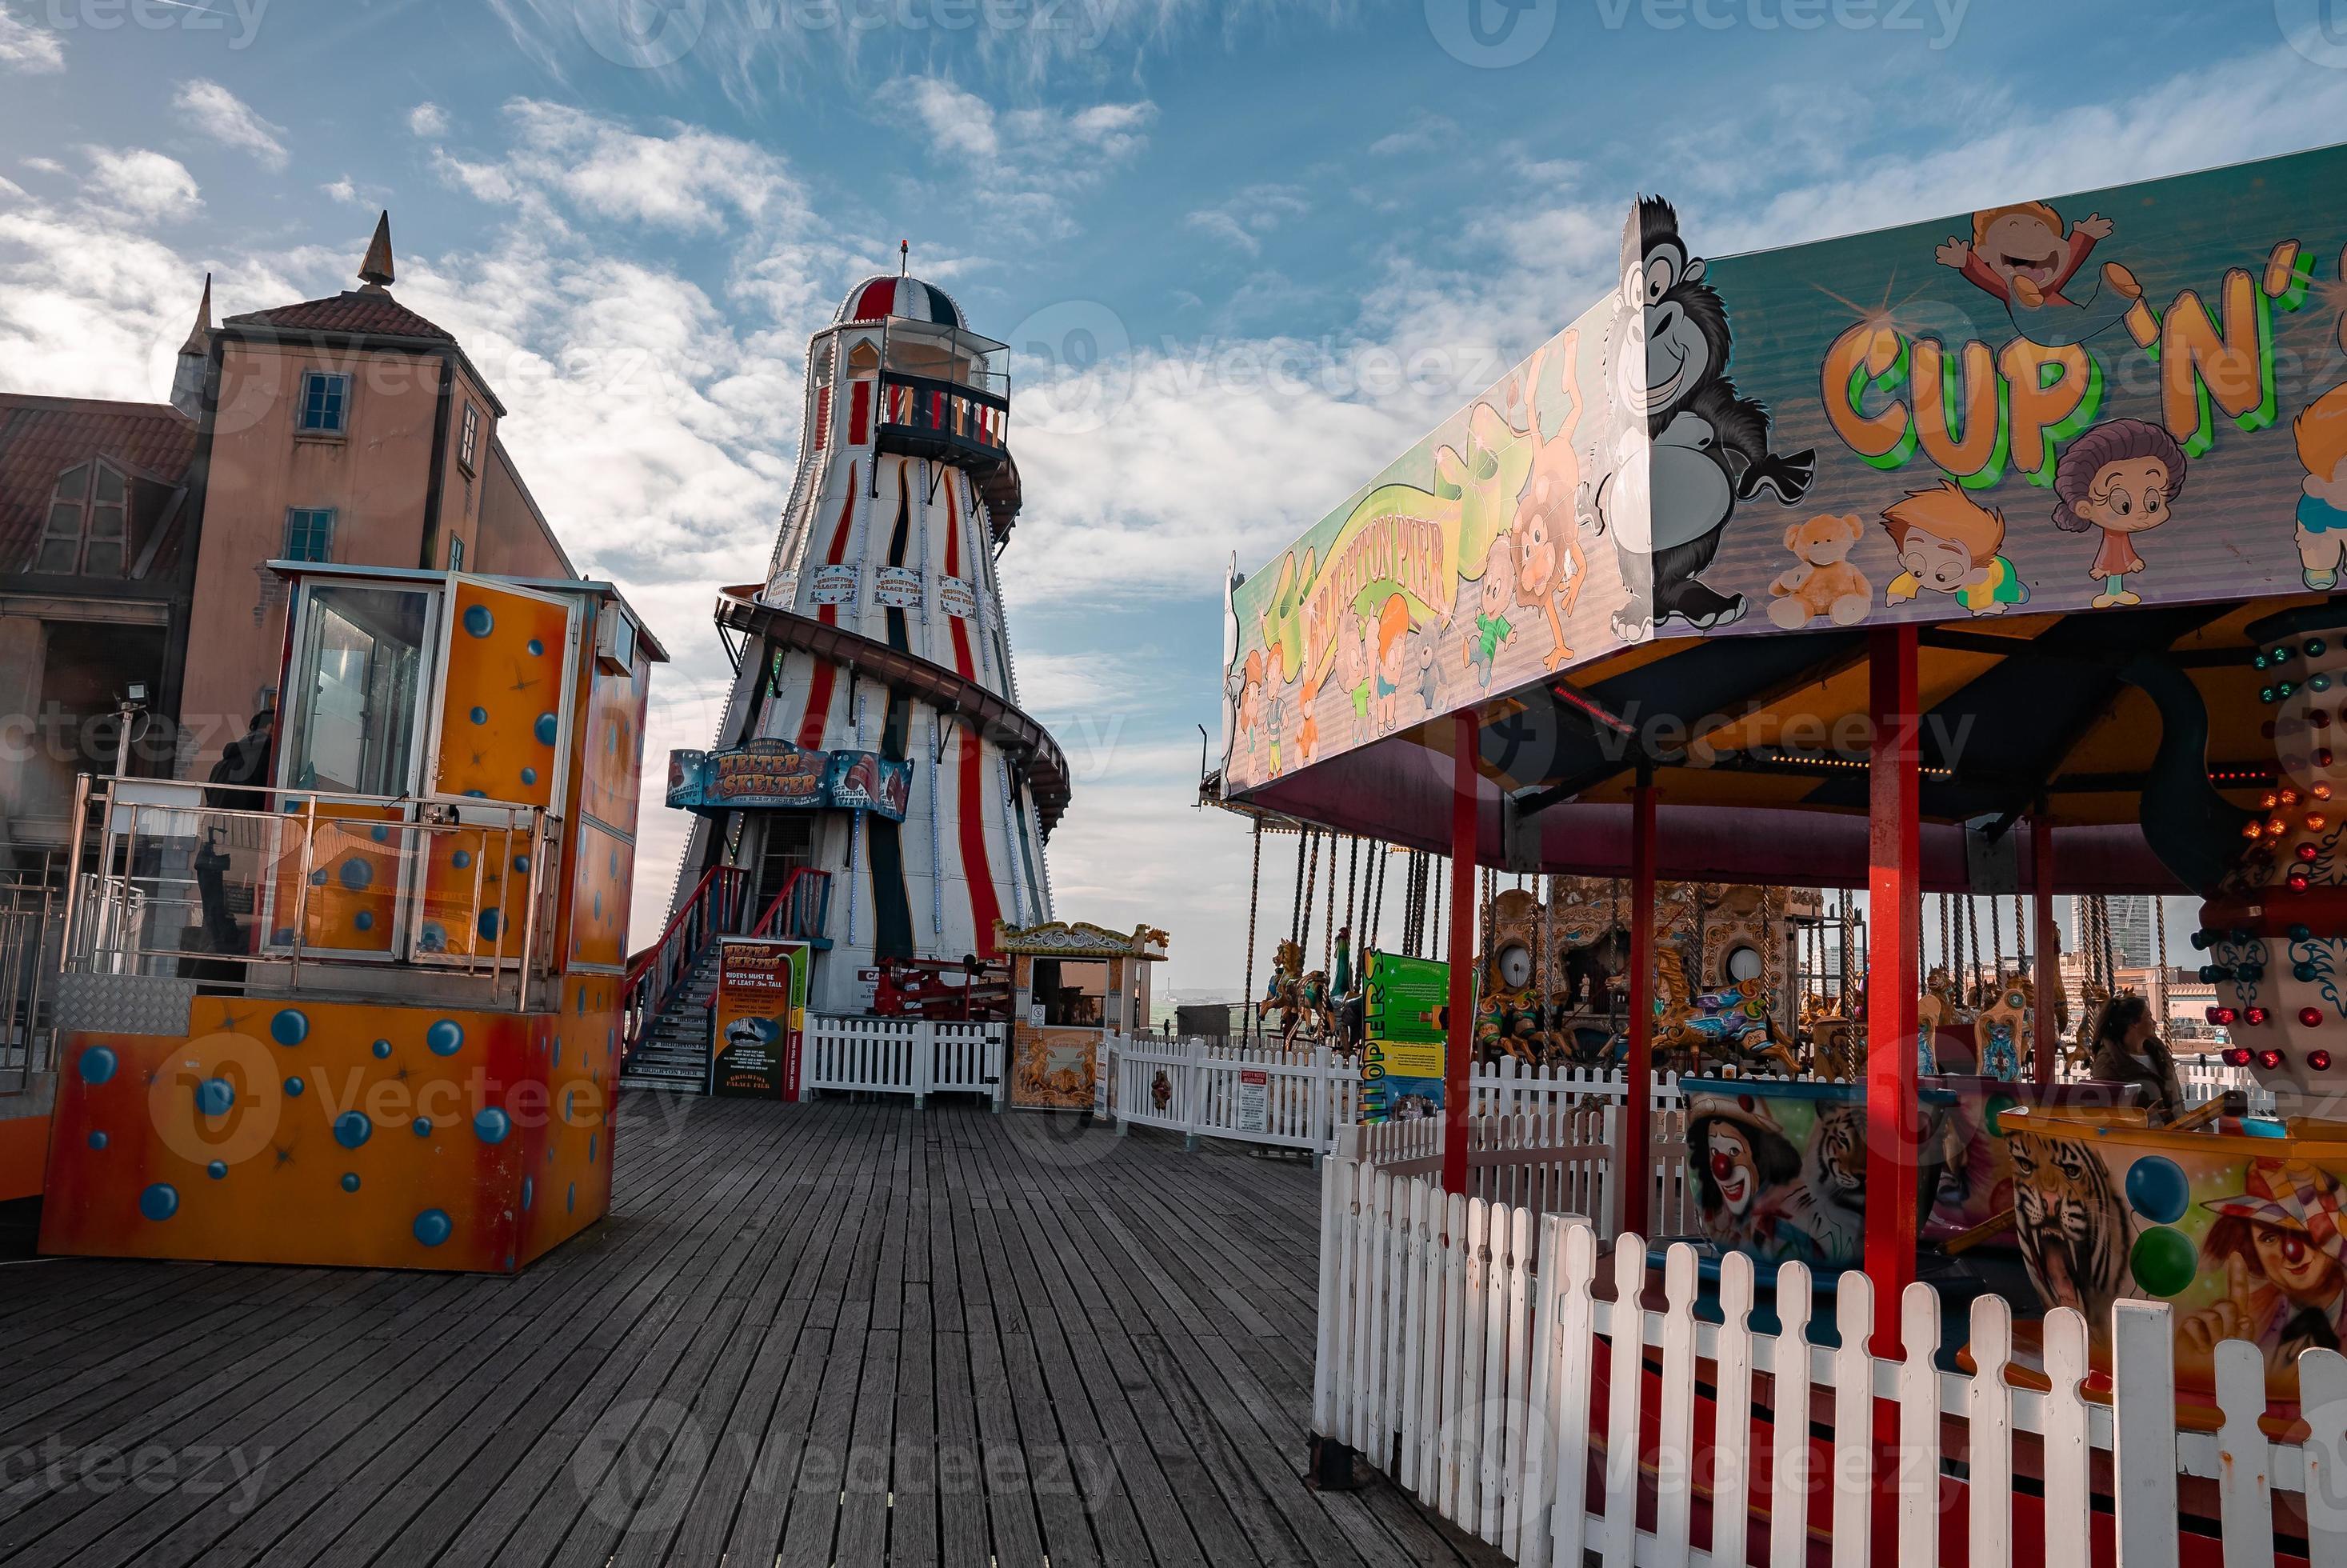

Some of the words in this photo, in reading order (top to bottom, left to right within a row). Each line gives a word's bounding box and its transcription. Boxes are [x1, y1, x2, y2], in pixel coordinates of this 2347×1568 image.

[1821, 318, 2105, 490] CUP
[1395, 514, 1448, 616] PIER
[817, 577, 854, 586] BRIGHTON
[880, 579, 918, 589] BRIGHTON
[876, 585, 903, 593] PALACE
[942, 589, 972, 600] BRIGHTON
[940, 594, 961, 604] PALACE
[718, 754, 800, 776] HELTER
[723, 774, 817, 797] SKELTER
[838, 798, 870, 806] VIEWS!
[724, 945, 770, 958] HELTER
[726, 956, 780, 970] SKELTER
